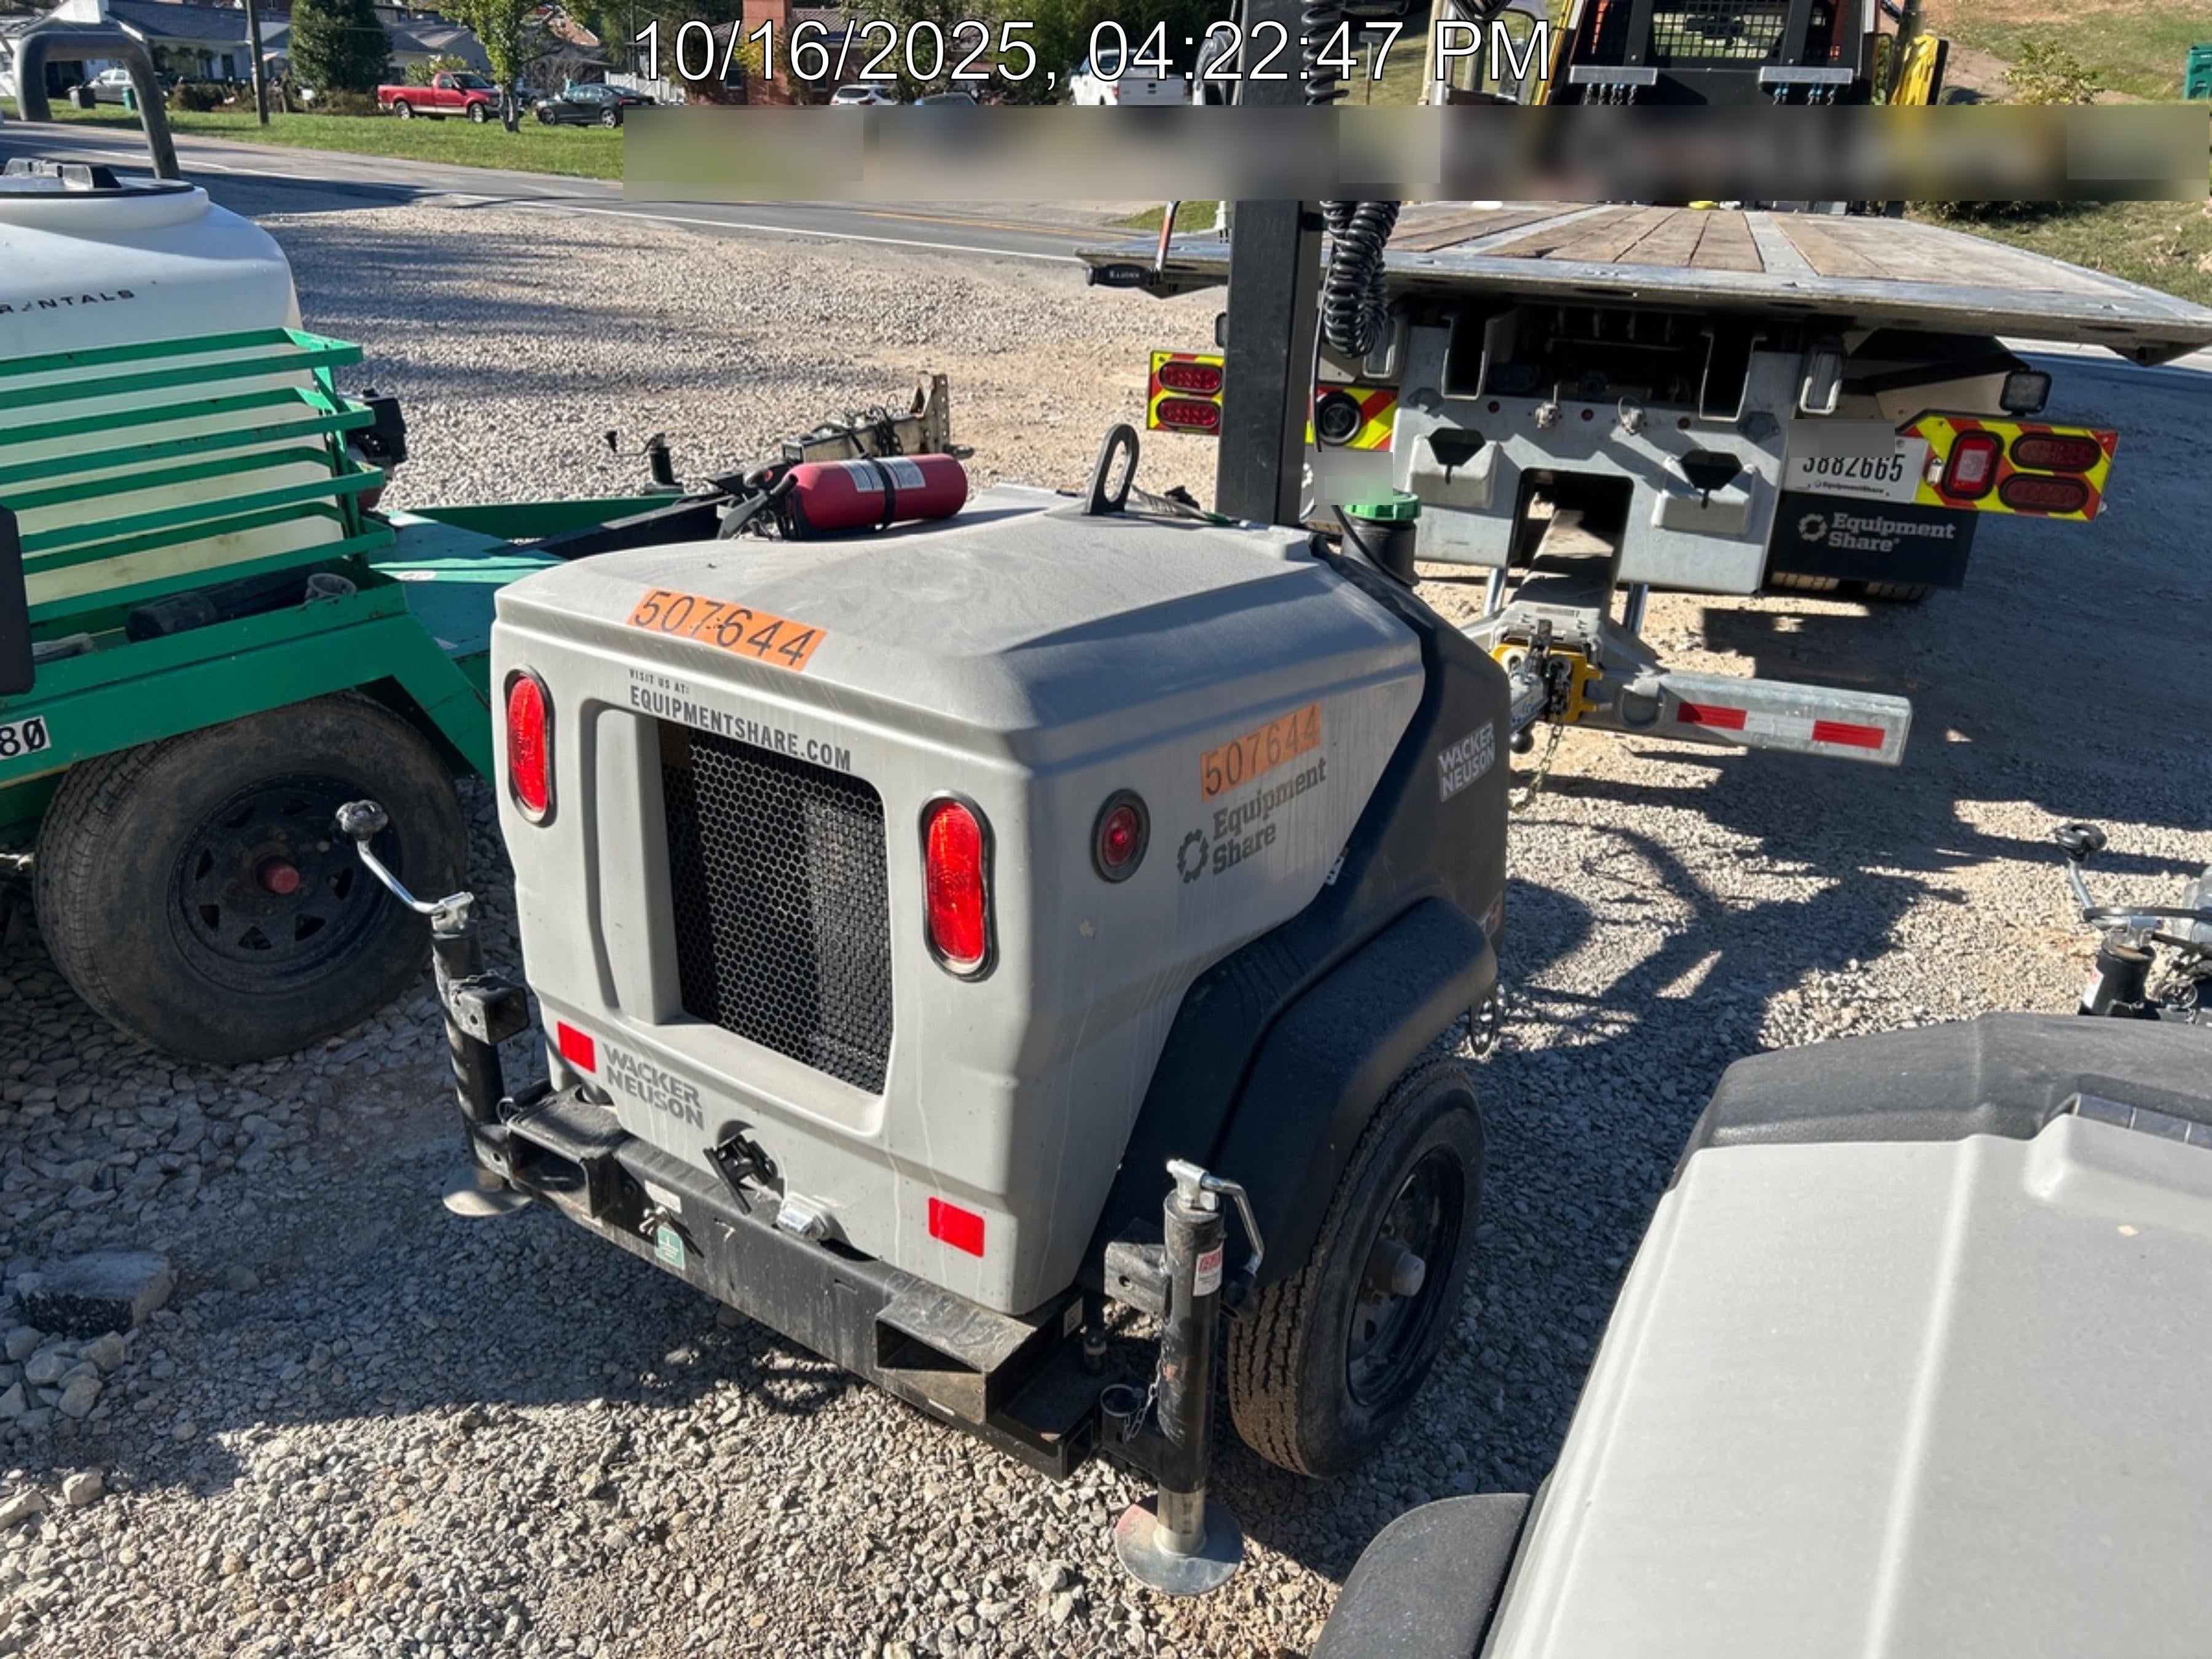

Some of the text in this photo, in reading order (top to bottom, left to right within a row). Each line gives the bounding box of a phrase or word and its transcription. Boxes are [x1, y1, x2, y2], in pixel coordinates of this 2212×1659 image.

[1832, 512, 1956, 539] Equipment
[635, 590, 817, 666] 507644
[629, 669, 689, 695] VISIT US AT:
[630, 685, 851, 771] EQUIPMENTSHARE.COM
[1205, 705, 1317, 796] 507644
[1438, 722, 1494, 773] WACKER
[1212, 756, 1326, 841] Equipment
[1442, 742, 1496, 797] NEUSON
[1212, 822, 1276, 875] Share
[602, 1043, 703, 1109] WACKER
[606, 1064, 705, 1131] NEUSON
